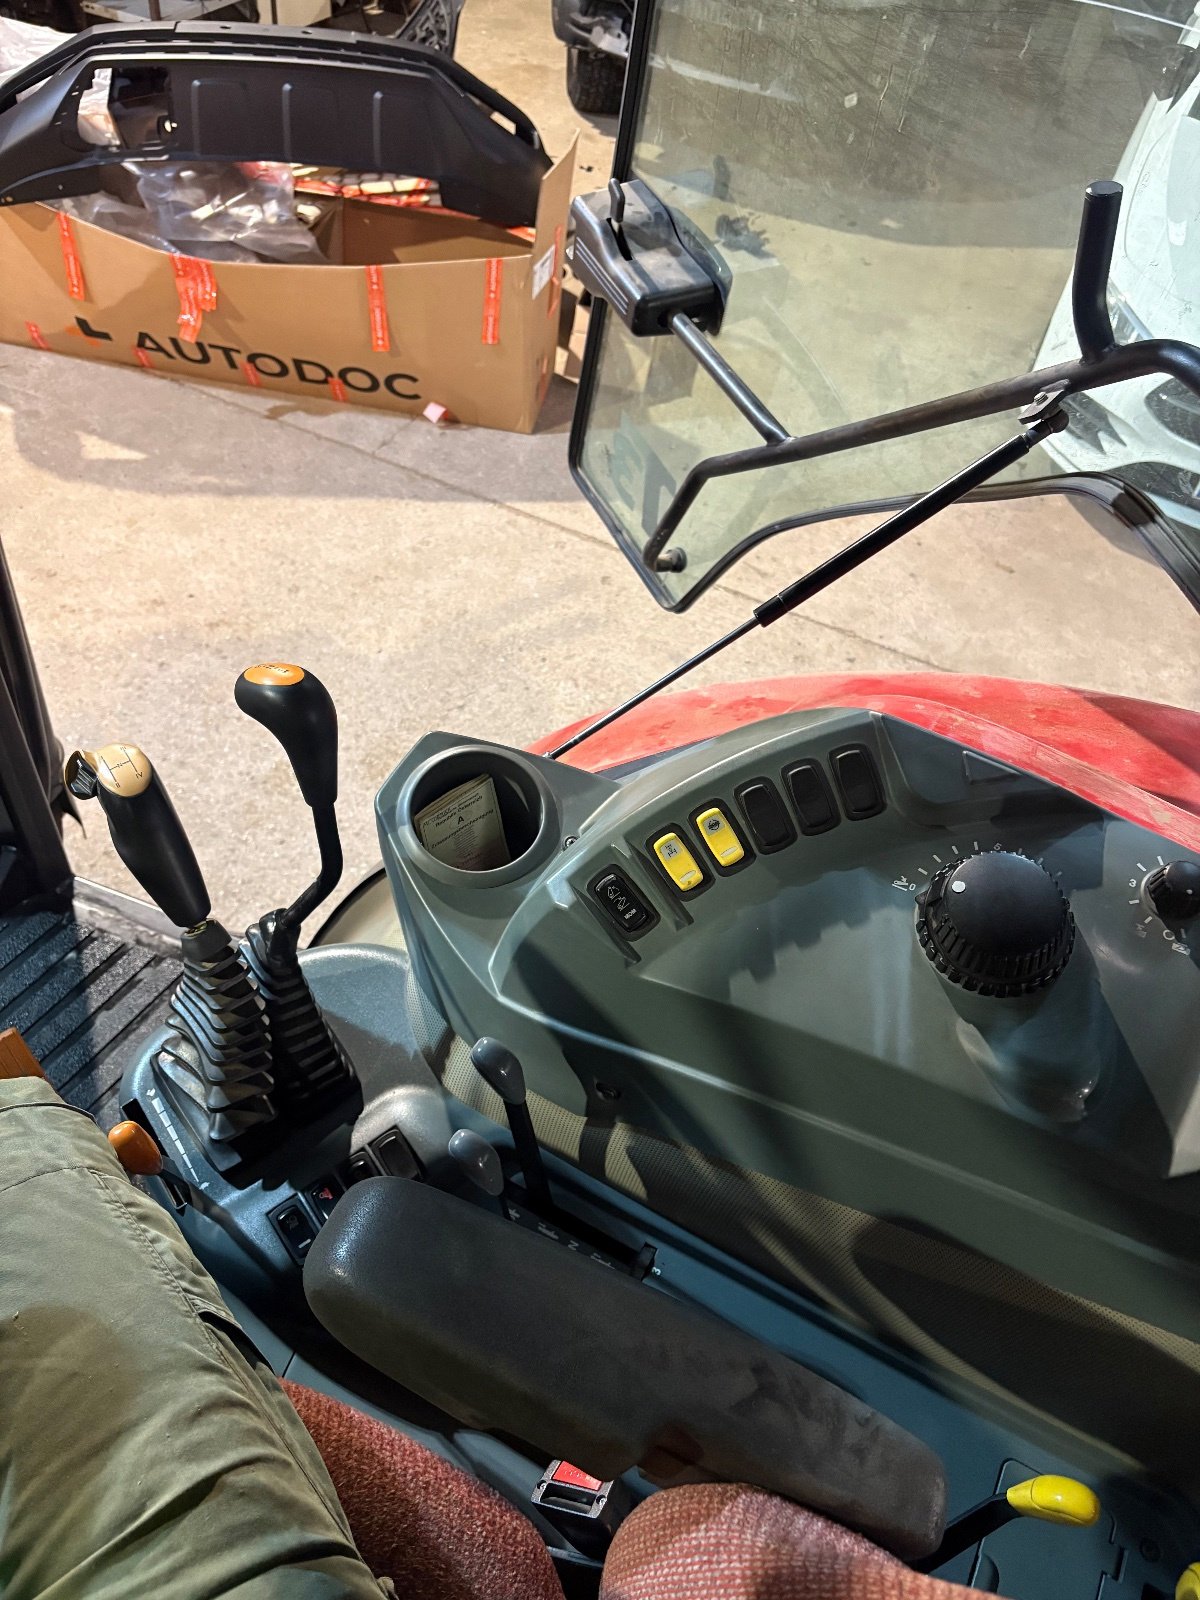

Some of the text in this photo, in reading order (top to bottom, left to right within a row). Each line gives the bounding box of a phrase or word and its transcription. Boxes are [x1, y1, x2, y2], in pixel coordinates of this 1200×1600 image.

[136, 331, 422, 400] AUTODOC
[457, 815, 465, 825] A
[1129, 879, 1136, 888] 3
[652, 1266, 661, 1276] 3
